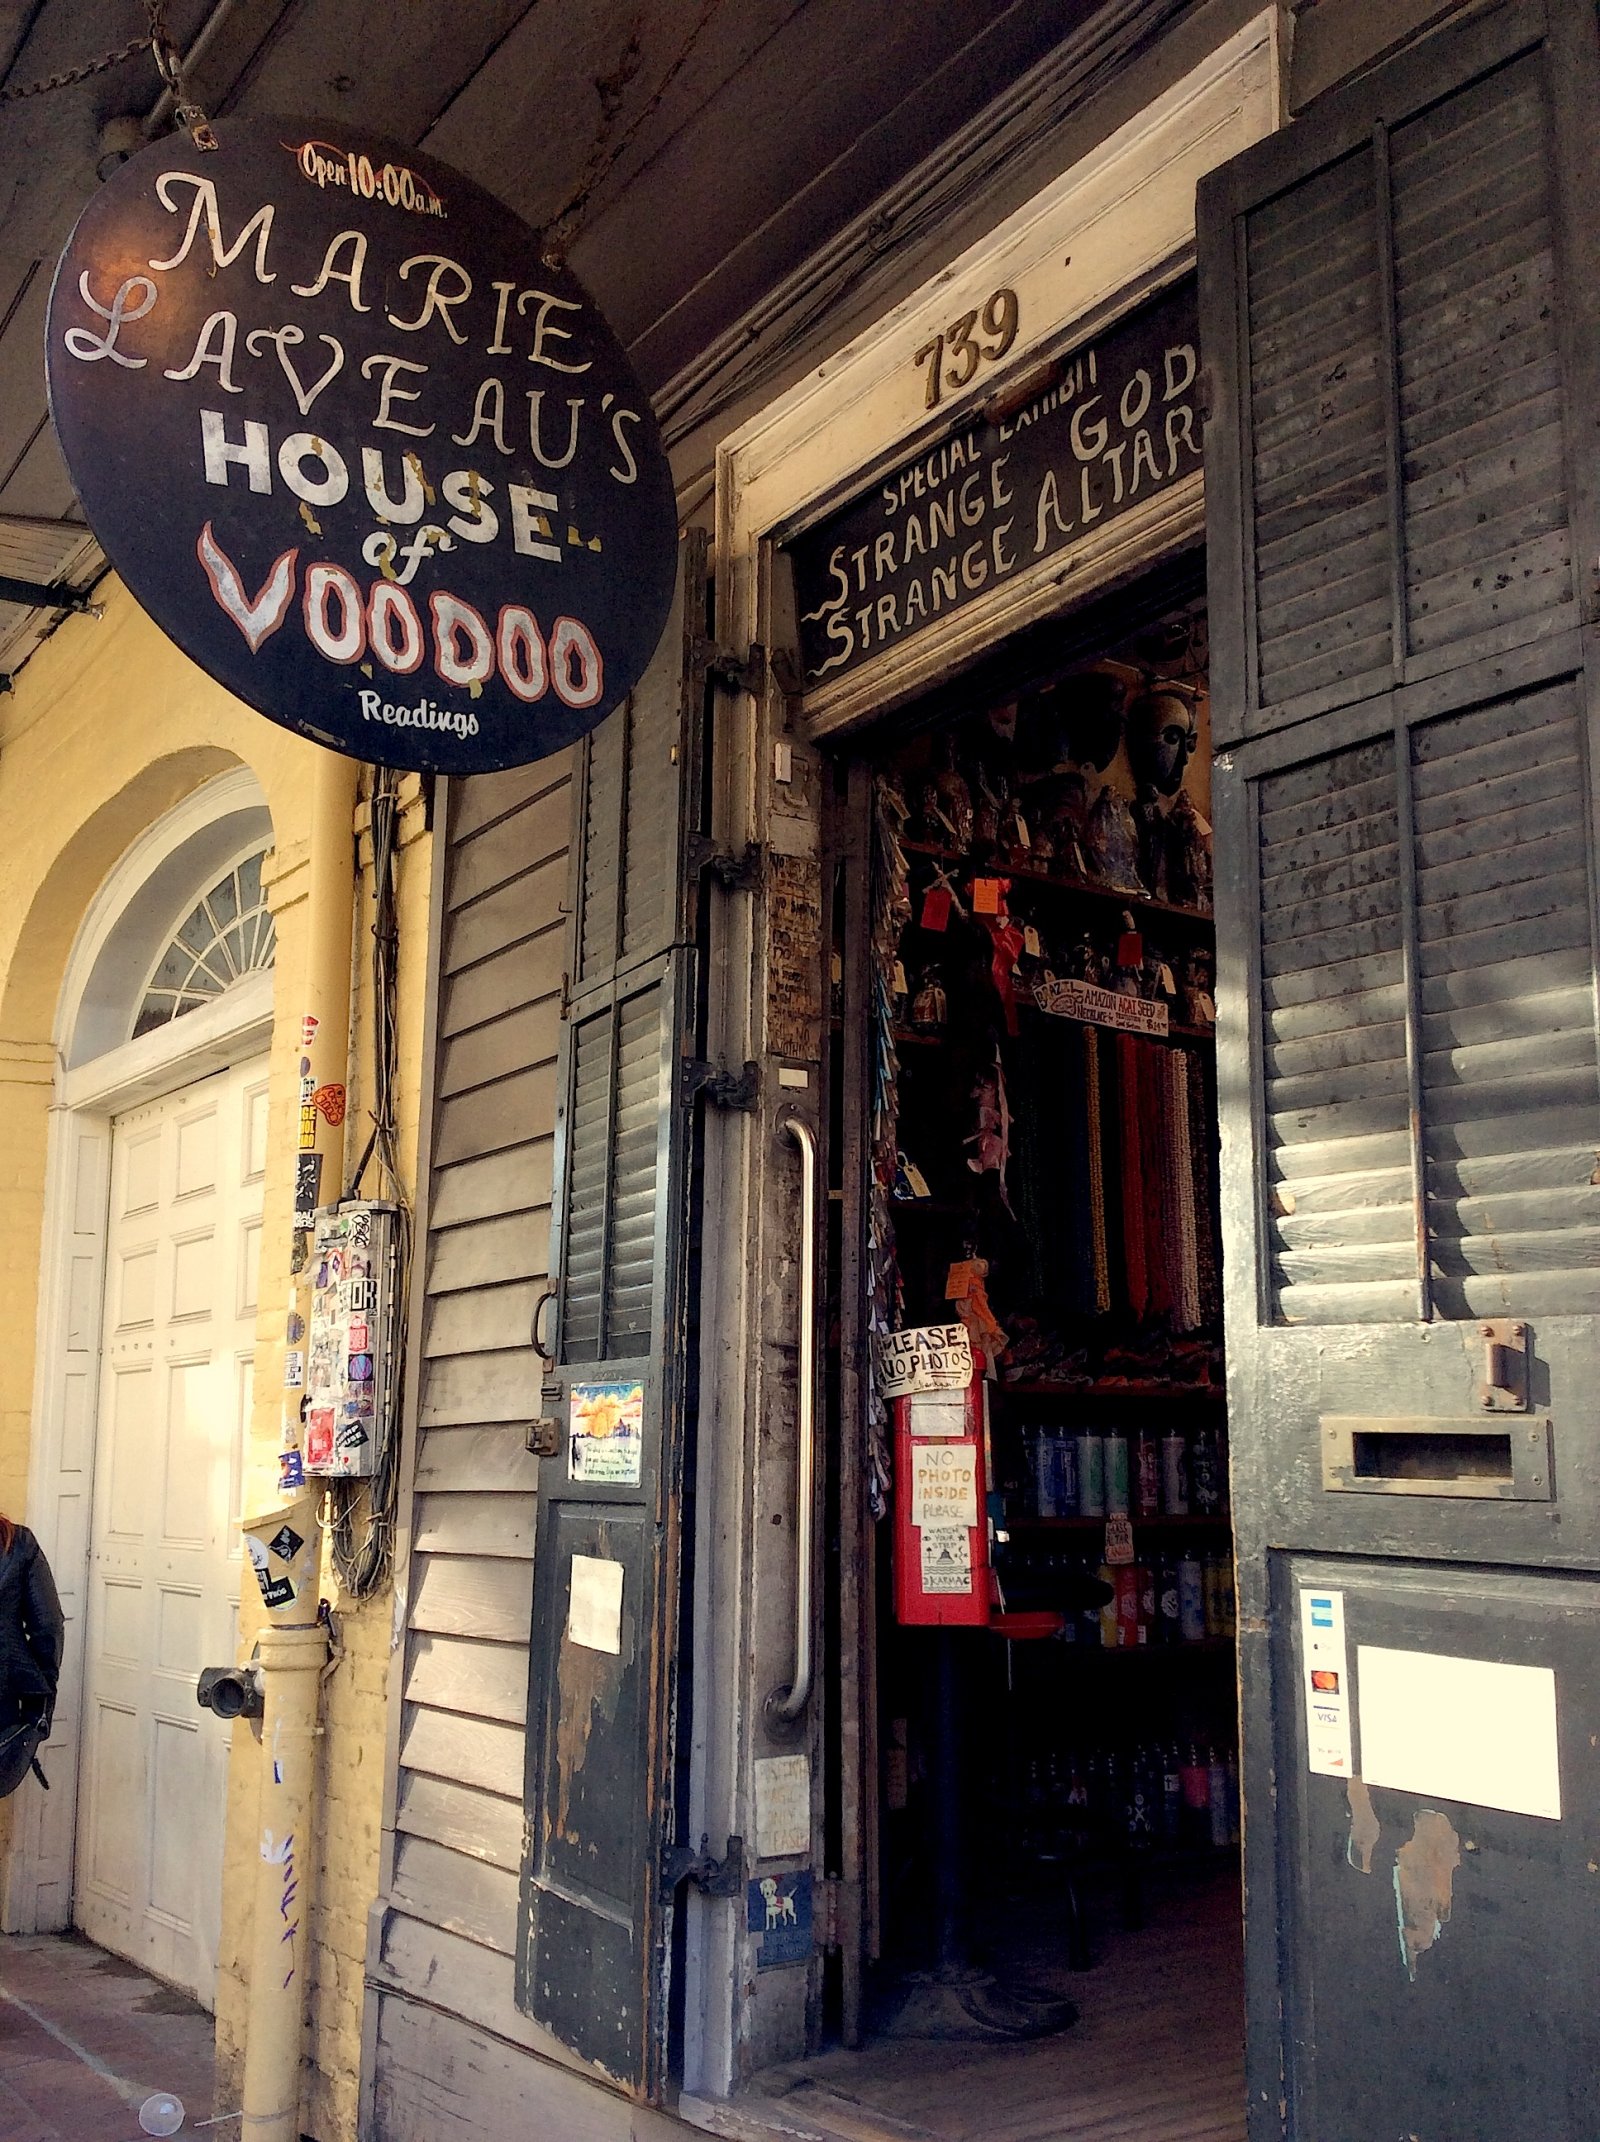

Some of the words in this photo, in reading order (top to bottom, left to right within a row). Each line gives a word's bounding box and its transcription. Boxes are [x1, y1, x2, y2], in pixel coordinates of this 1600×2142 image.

[303, 142, 347, 189] Open
[148, 171, 592, 373] MARIE
[914, 288, 1019, 410] 739
[64, 270, 641, 484] LAVEAU'S
[200, 410, 561, 562] HOUSE
[801, 451, 1014, 622] STRANGE
[1070, 343, 1197, 461] GOD
[882, 432, 982, 516] SPECIAL
[362, 525, 457, 585] of
[197, 519, 603, 708] VOODOO
[806, 515, 1017, 676] STRANGE
[358, 689, 480, 736] Readings
[1085, 989, 1117, 1011] AMAZON
[880, 1359, 906, 1378] NO
[908, 1350, 972, 1377] PHOTOS
[918, 1468, 971, 1484] PHOTO
[926, 1450, 954, 1466] NO
[918, 1486, 968, 1500] INSIDE
[922, 1503, 964, 1519] PLEASE
[928, 1526, 959, 1535] WATCH
[930, 1575, 964, 1586] KARMA
[1317, 1713, 1338, 1723] VISA
